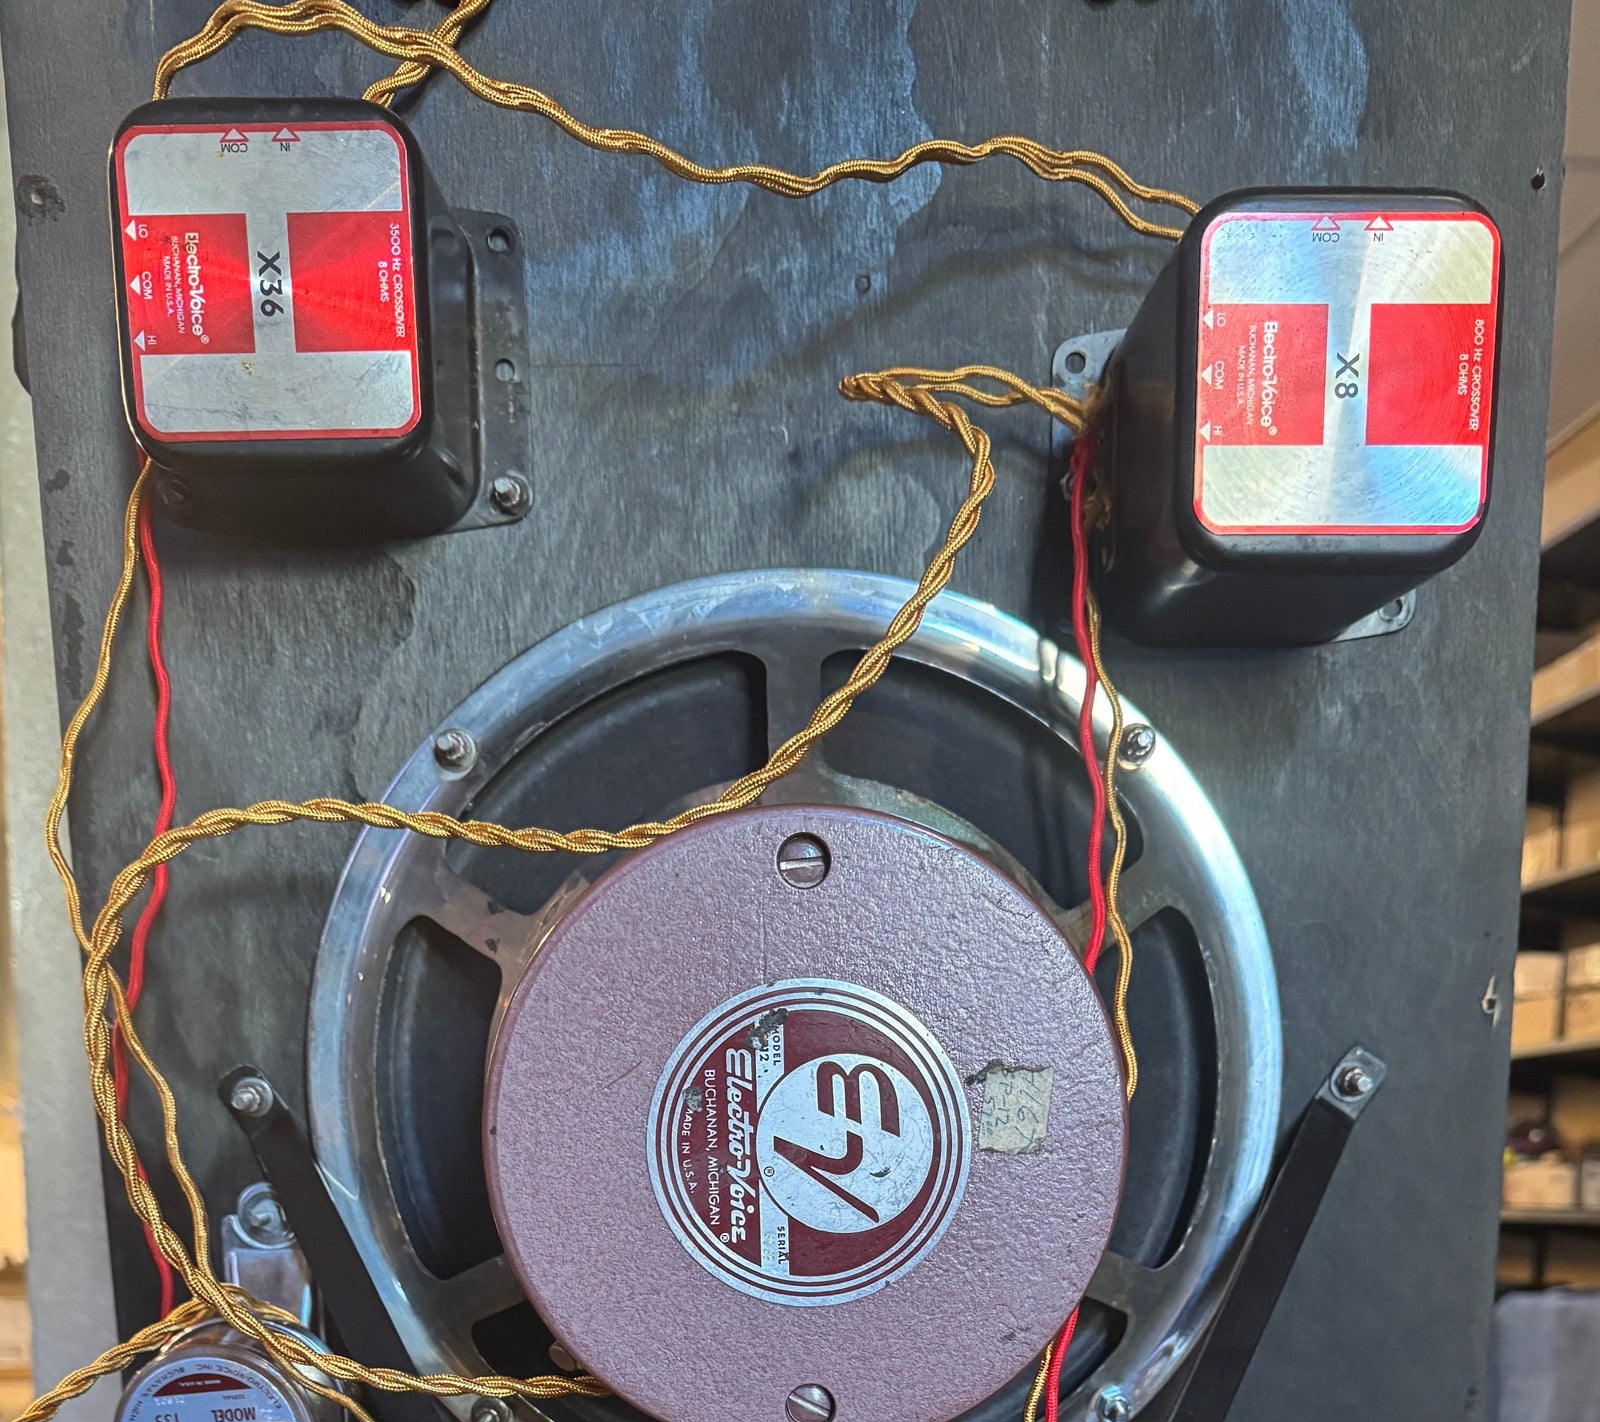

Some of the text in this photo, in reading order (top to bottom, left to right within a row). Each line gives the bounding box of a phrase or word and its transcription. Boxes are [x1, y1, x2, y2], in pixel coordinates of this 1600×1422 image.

[220, 143, 248, 153] COM
[280, 142, 291, 151] IN
[138, 224, 149, 239] LO
[1312, 232, 1340, 243] COM
[1373, 233, 1384, 242] IN
[142, 271, 153, 300] COM
[163, 256, 176, 317] MADE IN U.S.A.
[171, 235, 186, 334] BUCHANAN, MICHIGAN
[257, 251, 283, 318] X36
[379, 269, 389, 302] OHMS
[390, 223, 405, 338] 3500 Hz CROSSOVER
[1216, 312, 1227, 327] LO
[147, 335, 157, 346] HI
[1213, 360, 1225, 390] COM
[1236, 345, 1246, 407] MADE IN U.S.A.
[1246, 325, 1257, 426] BUCHANAN, MICHIGAN
[1334, 352, 1360, 400] X8
[1457, 363, 1468, 396] OHMS
[1469, 319, 1484, 431] 800 Hz CROSSOVER
[1213, 425, 1224, 436] HI
[772, 1024, 782, 1066] MODEL
[682, 1142, 690, 1154] IN
[704, 1069, 720, 1225] BUCHANAN, MICHIGAN
[773, 1061, 901, 1224] EV
[682, 1159, 696, 1194] U.S.A.
[777, 1226, 786, 1265] SERIAL
[211, 1407, 256, 1422] MODEL
